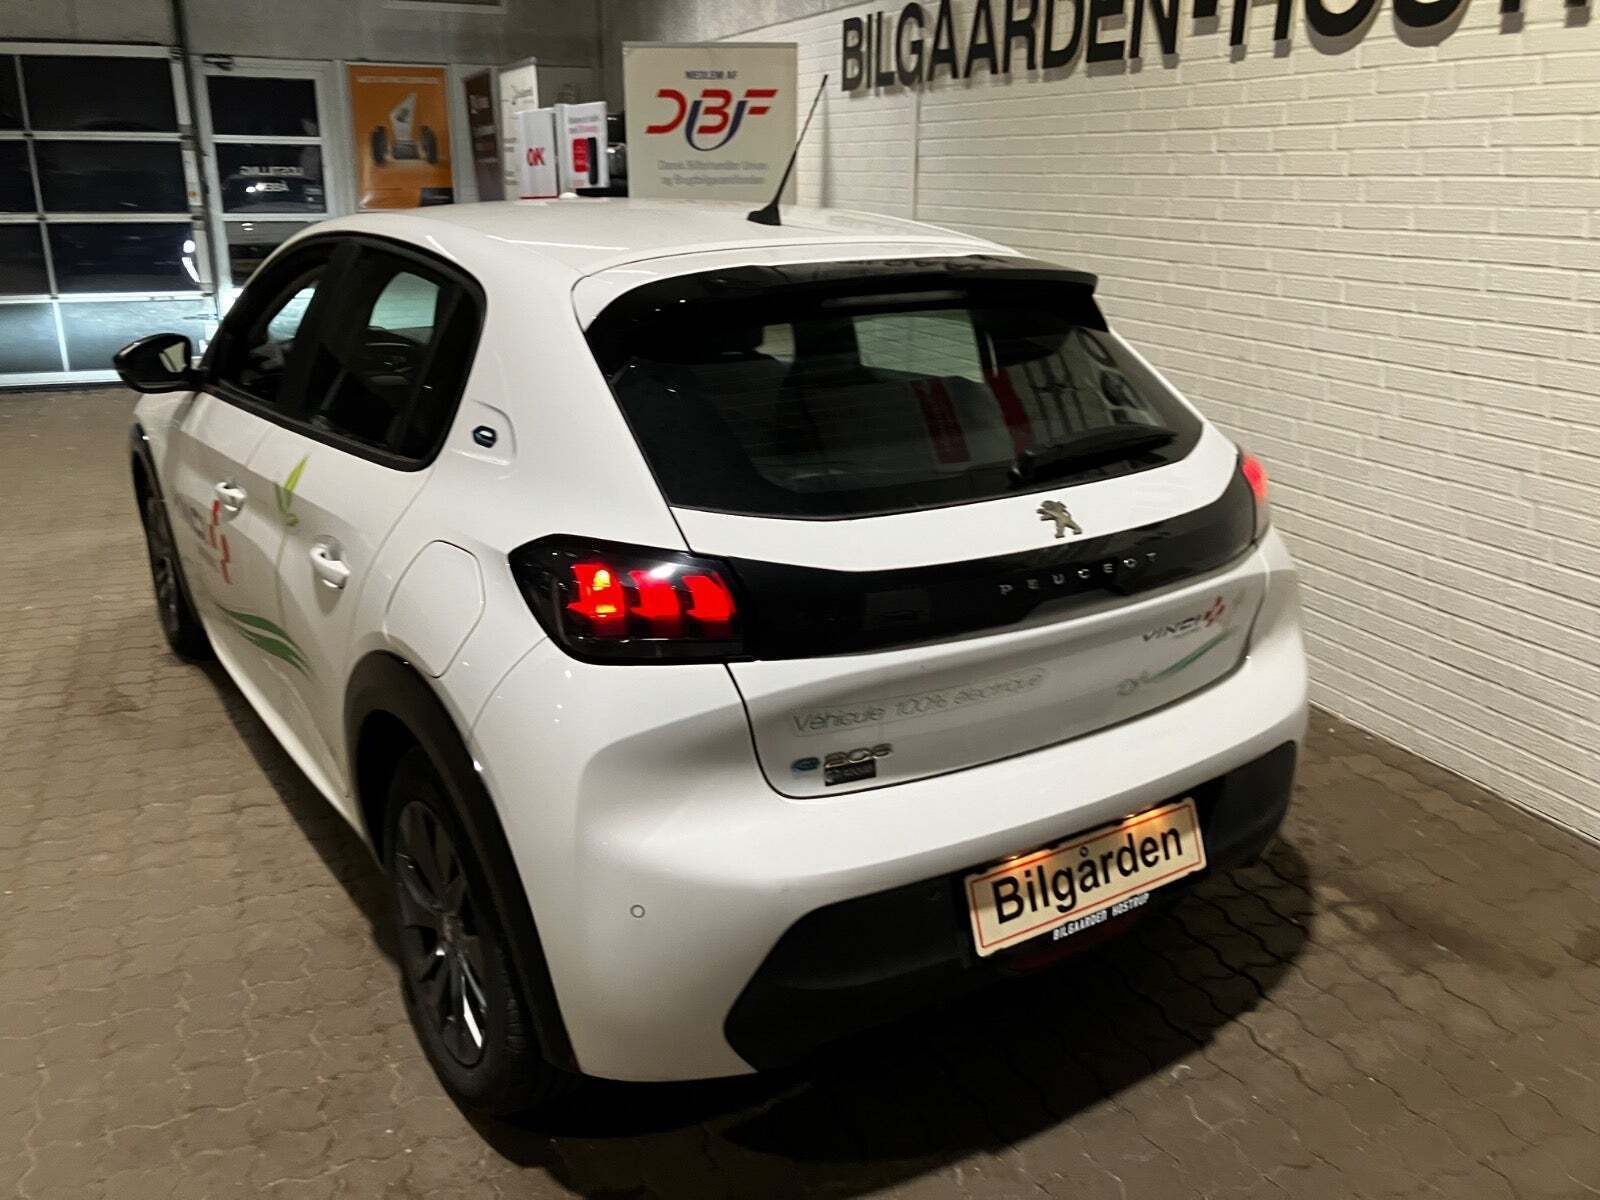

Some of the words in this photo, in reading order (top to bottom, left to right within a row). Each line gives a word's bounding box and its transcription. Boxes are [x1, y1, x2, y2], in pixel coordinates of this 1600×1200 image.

[999, 552, 1158, 595] PEUGEOT
[991, 827, 1183, 925] Bilgården
[1053, 909, 1108, 941] BILGAARDEN
